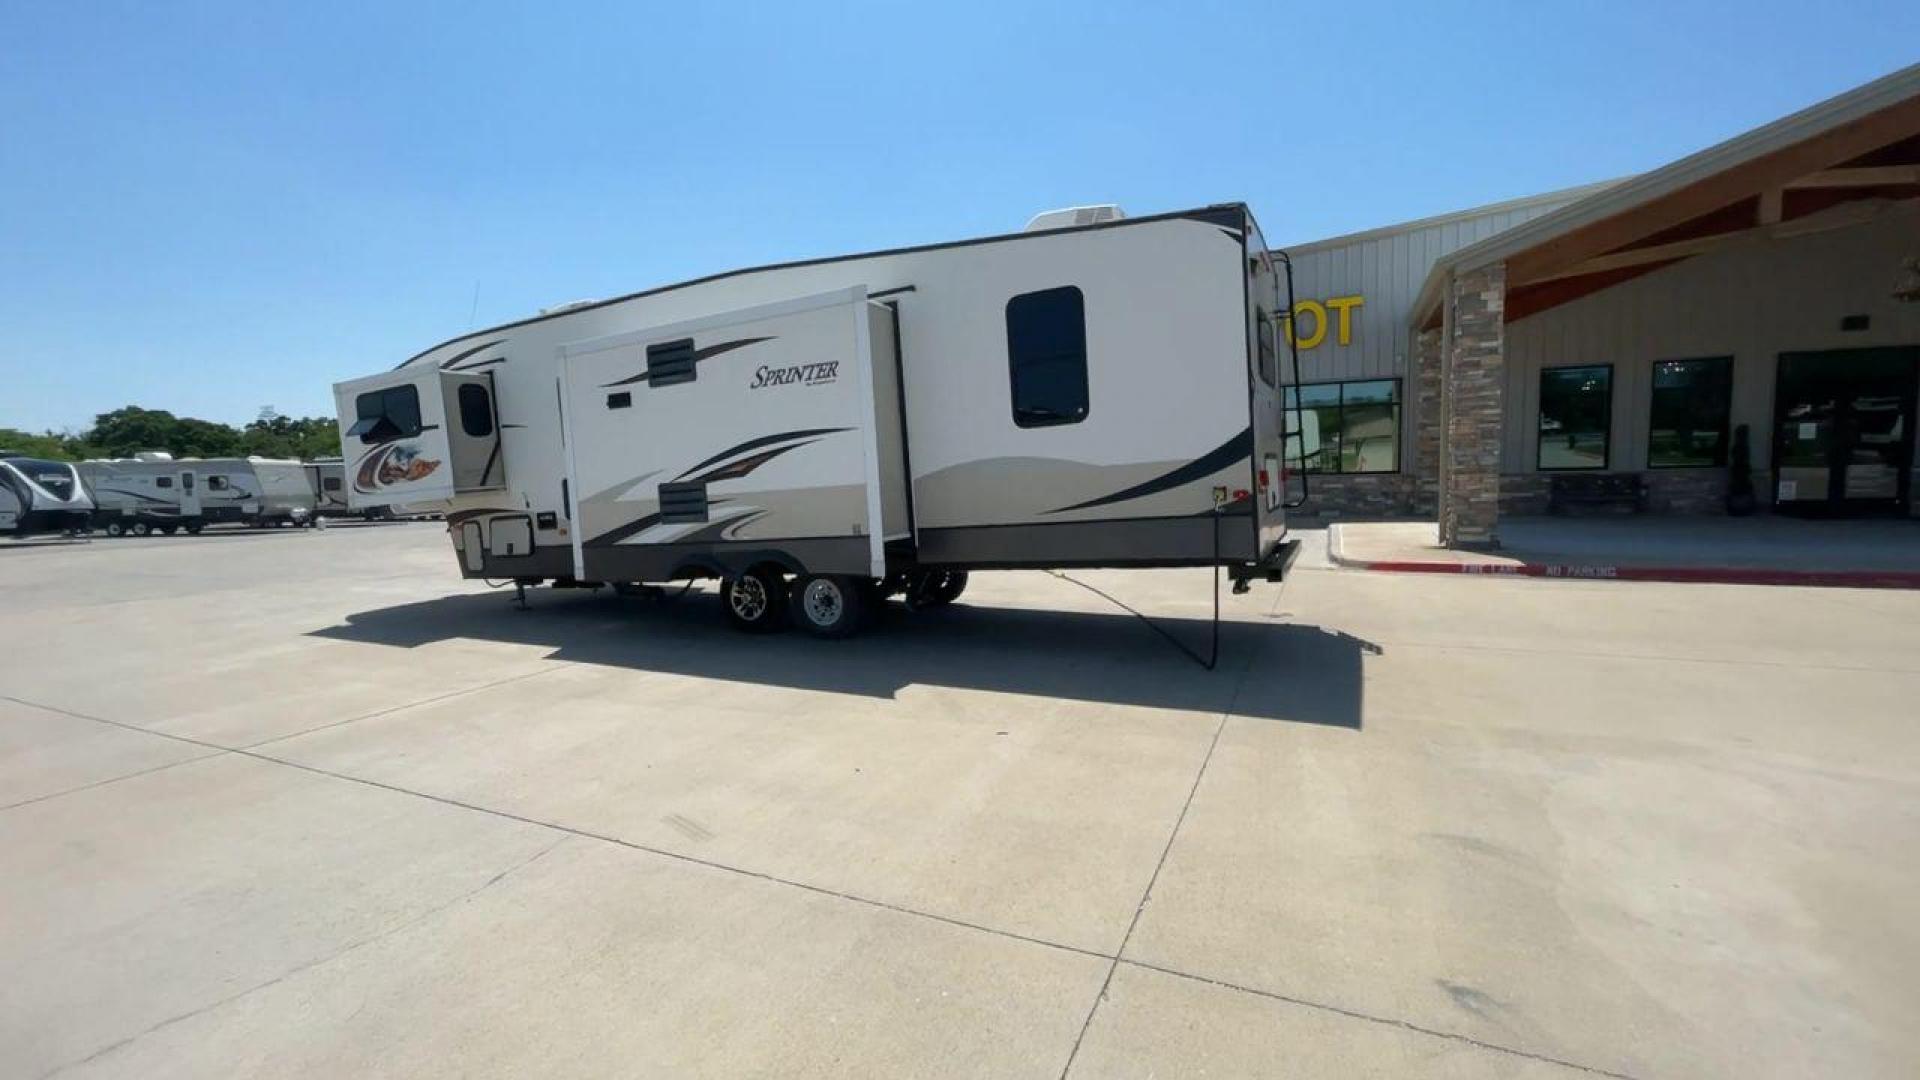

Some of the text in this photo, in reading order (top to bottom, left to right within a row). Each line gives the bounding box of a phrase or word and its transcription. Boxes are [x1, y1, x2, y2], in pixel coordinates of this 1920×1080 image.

[750, 360, 839, 389] SPRINTER
[1546, 565, 1617, 577] NO PARKING
